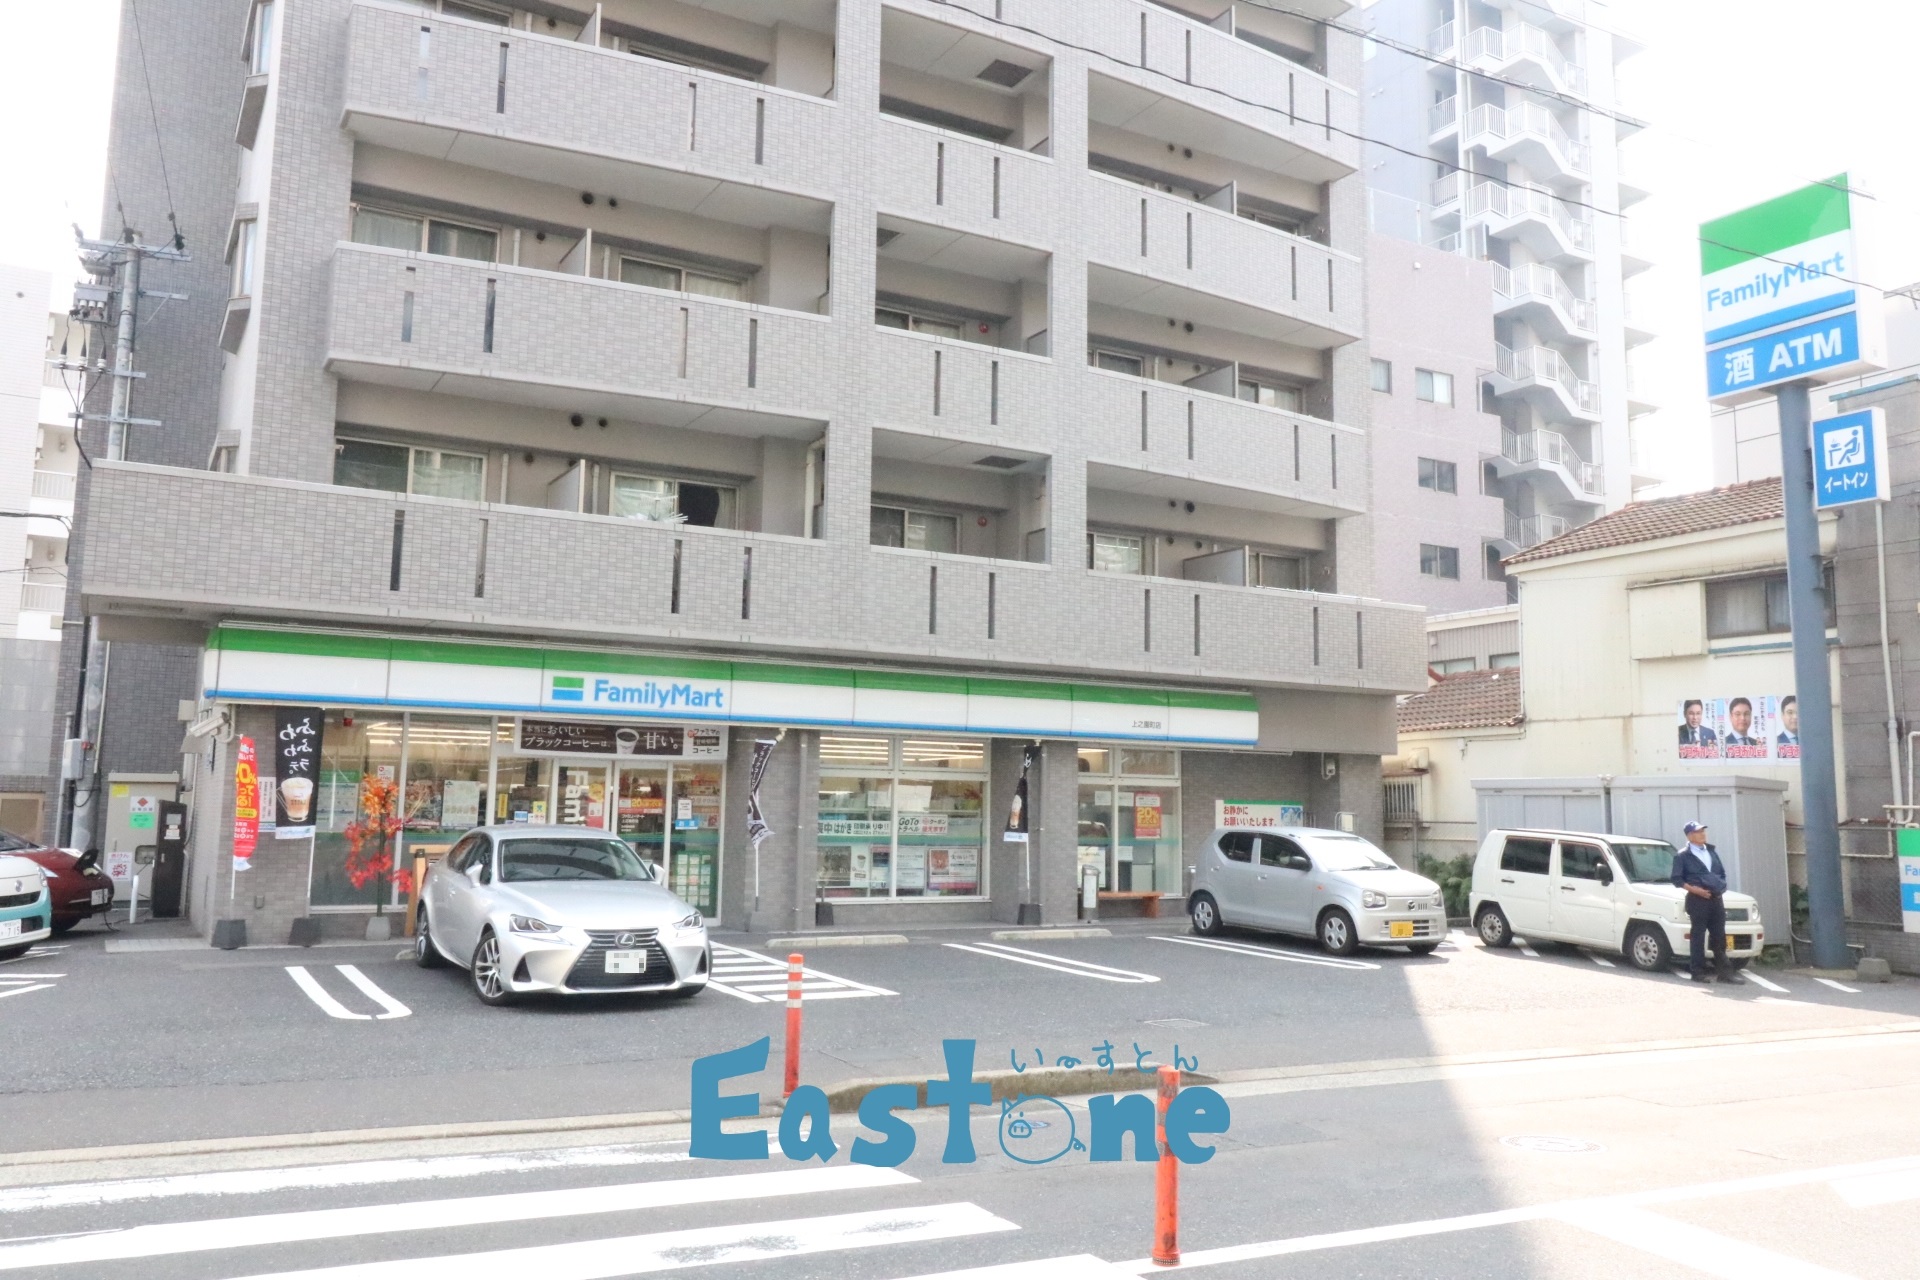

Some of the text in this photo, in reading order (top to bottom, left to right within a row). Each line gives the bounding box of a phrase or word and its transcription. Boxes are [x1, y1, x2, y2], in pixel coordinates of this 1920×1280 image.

[1707, 251, 1845, 312] FamilyMart
[1725, 328, 1843, 386] 酒 ATM
[1825, 471, 1869, 494] イートイン
[594, 679, 724, 709] FamilyMart
[643, 731, 679, 750] 甘い。
[1223, 805, 1249, 815] お静かに
[1904, 864, 1920, 876] Fa
